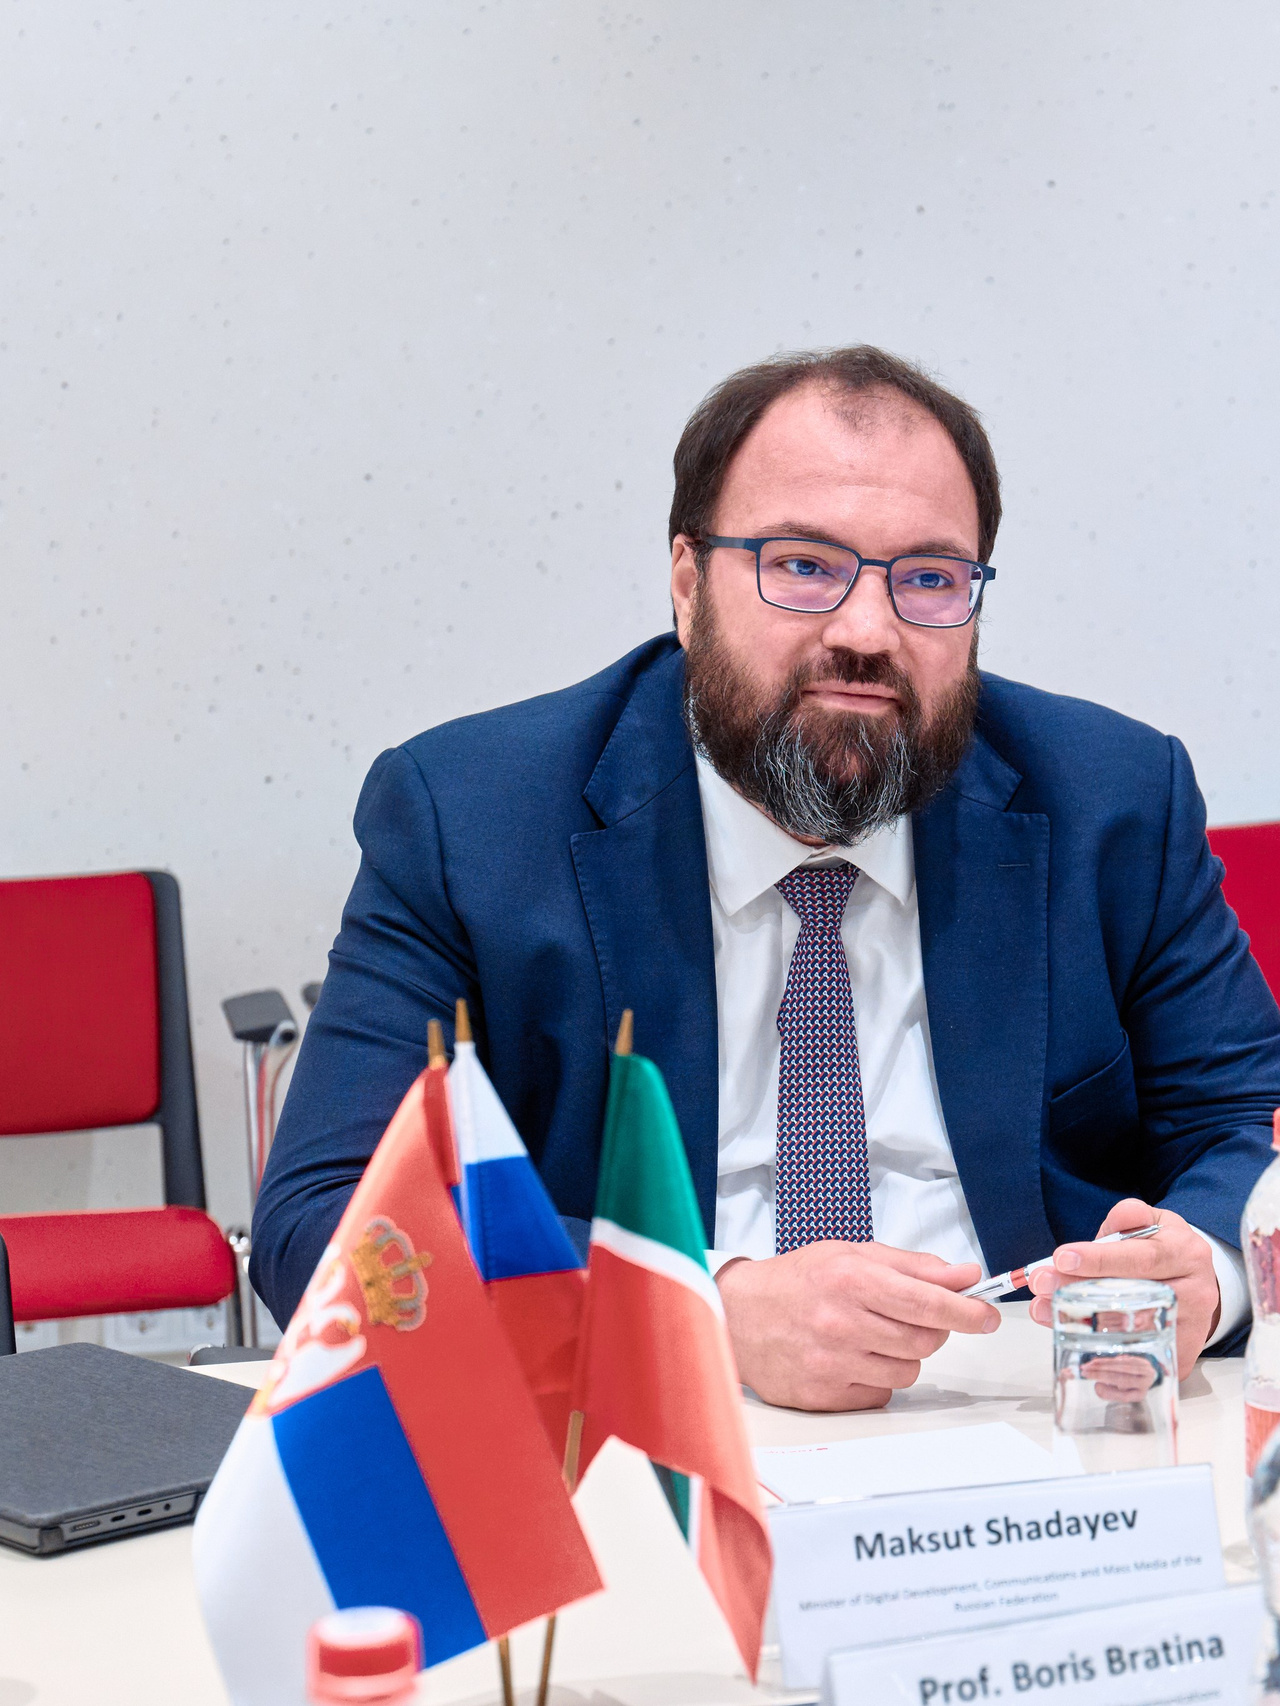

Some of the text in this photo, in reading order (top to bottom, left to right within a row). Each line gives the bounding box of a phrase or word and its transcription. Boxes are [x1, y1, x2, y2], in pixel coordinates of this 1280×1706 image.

[854, 1509, 1138, 1562] Maksut Shadayev
[799, 1599, 846, 1611] Minister
[850, 1594, 861, 1604] of
[864, 1591, 899, 1605] Digital
[984, 1569, 1077, 1591] Communications
[1080, 1566, 1100, 1578] and
[1103, 1563, 1131, 1575] Mass
[1134, 1558, 1168, 1571] Media
[1171, 1556, 1182, 1567] of
[1184, 1554, 1203, 1565] the
[954, 1591, 1059, 1612] Russian Federation
[918, 1634, 1226, 1706] Prof. Boris Bratina
